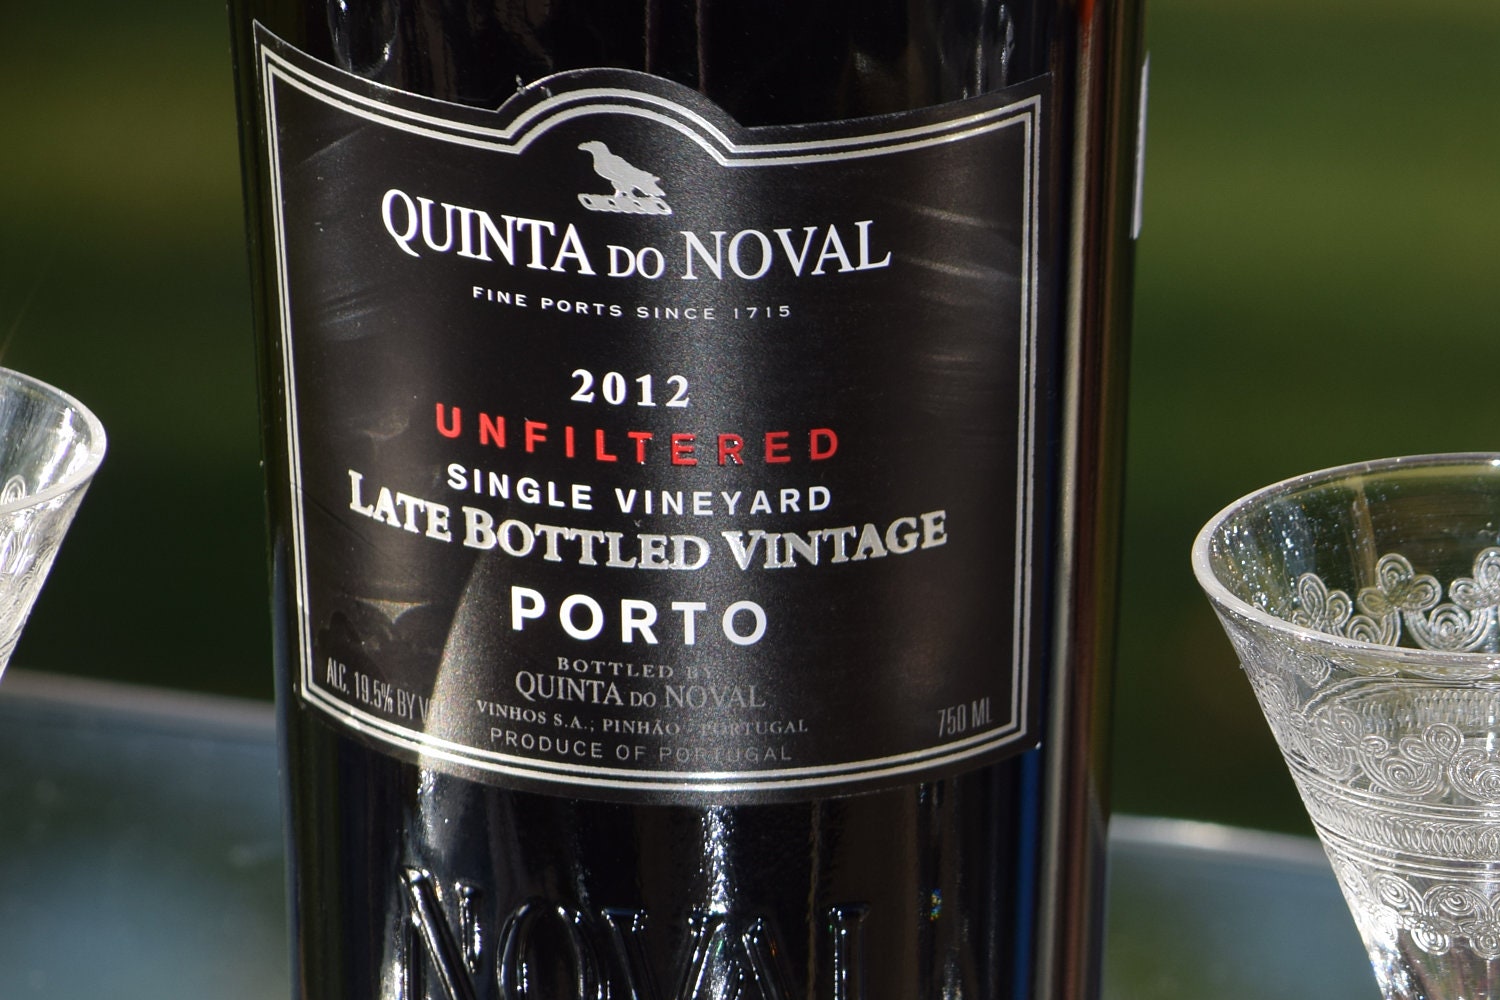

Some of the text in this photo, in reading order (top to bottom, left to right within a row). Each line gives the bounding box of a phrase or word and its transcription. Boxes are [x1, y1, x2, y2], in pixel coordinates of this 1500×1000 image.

[381, 188, 597, 276] QUINTA
[680, 220, 892, 281] NOVAL
[472, 286, 792, 320] FINE PORTS SINCE 1715
[570, 369, 690, 408] 2012
[434, 402, 839, 467] UNFILTERED
[447, 462, 832, 516] SINGLE VINEYARD
[348, 469, 948, 571] LATE BOTTLED VINTAGE
[511, 585, 767, 646] PORTO
[326, 656, 350, 695] ALC.
[354, 671, 393, 714] 19.5%
[397, 688, 416, 721] BY
[557, 657, 674, 679] BOTTLED
[515, 670, 624, 706] QUINTA
[665, 684, 766, 709] NOVAL
[476, 700, 547, 725] VINHOS
[602, 718, 681, 735] PINHÃO
[700, 718, 809, 737] PORTUGAL
[937, 696, 994, 738] 750 ML
[490, 727, 793, 763] PRODUCE OF PORTUGAL
